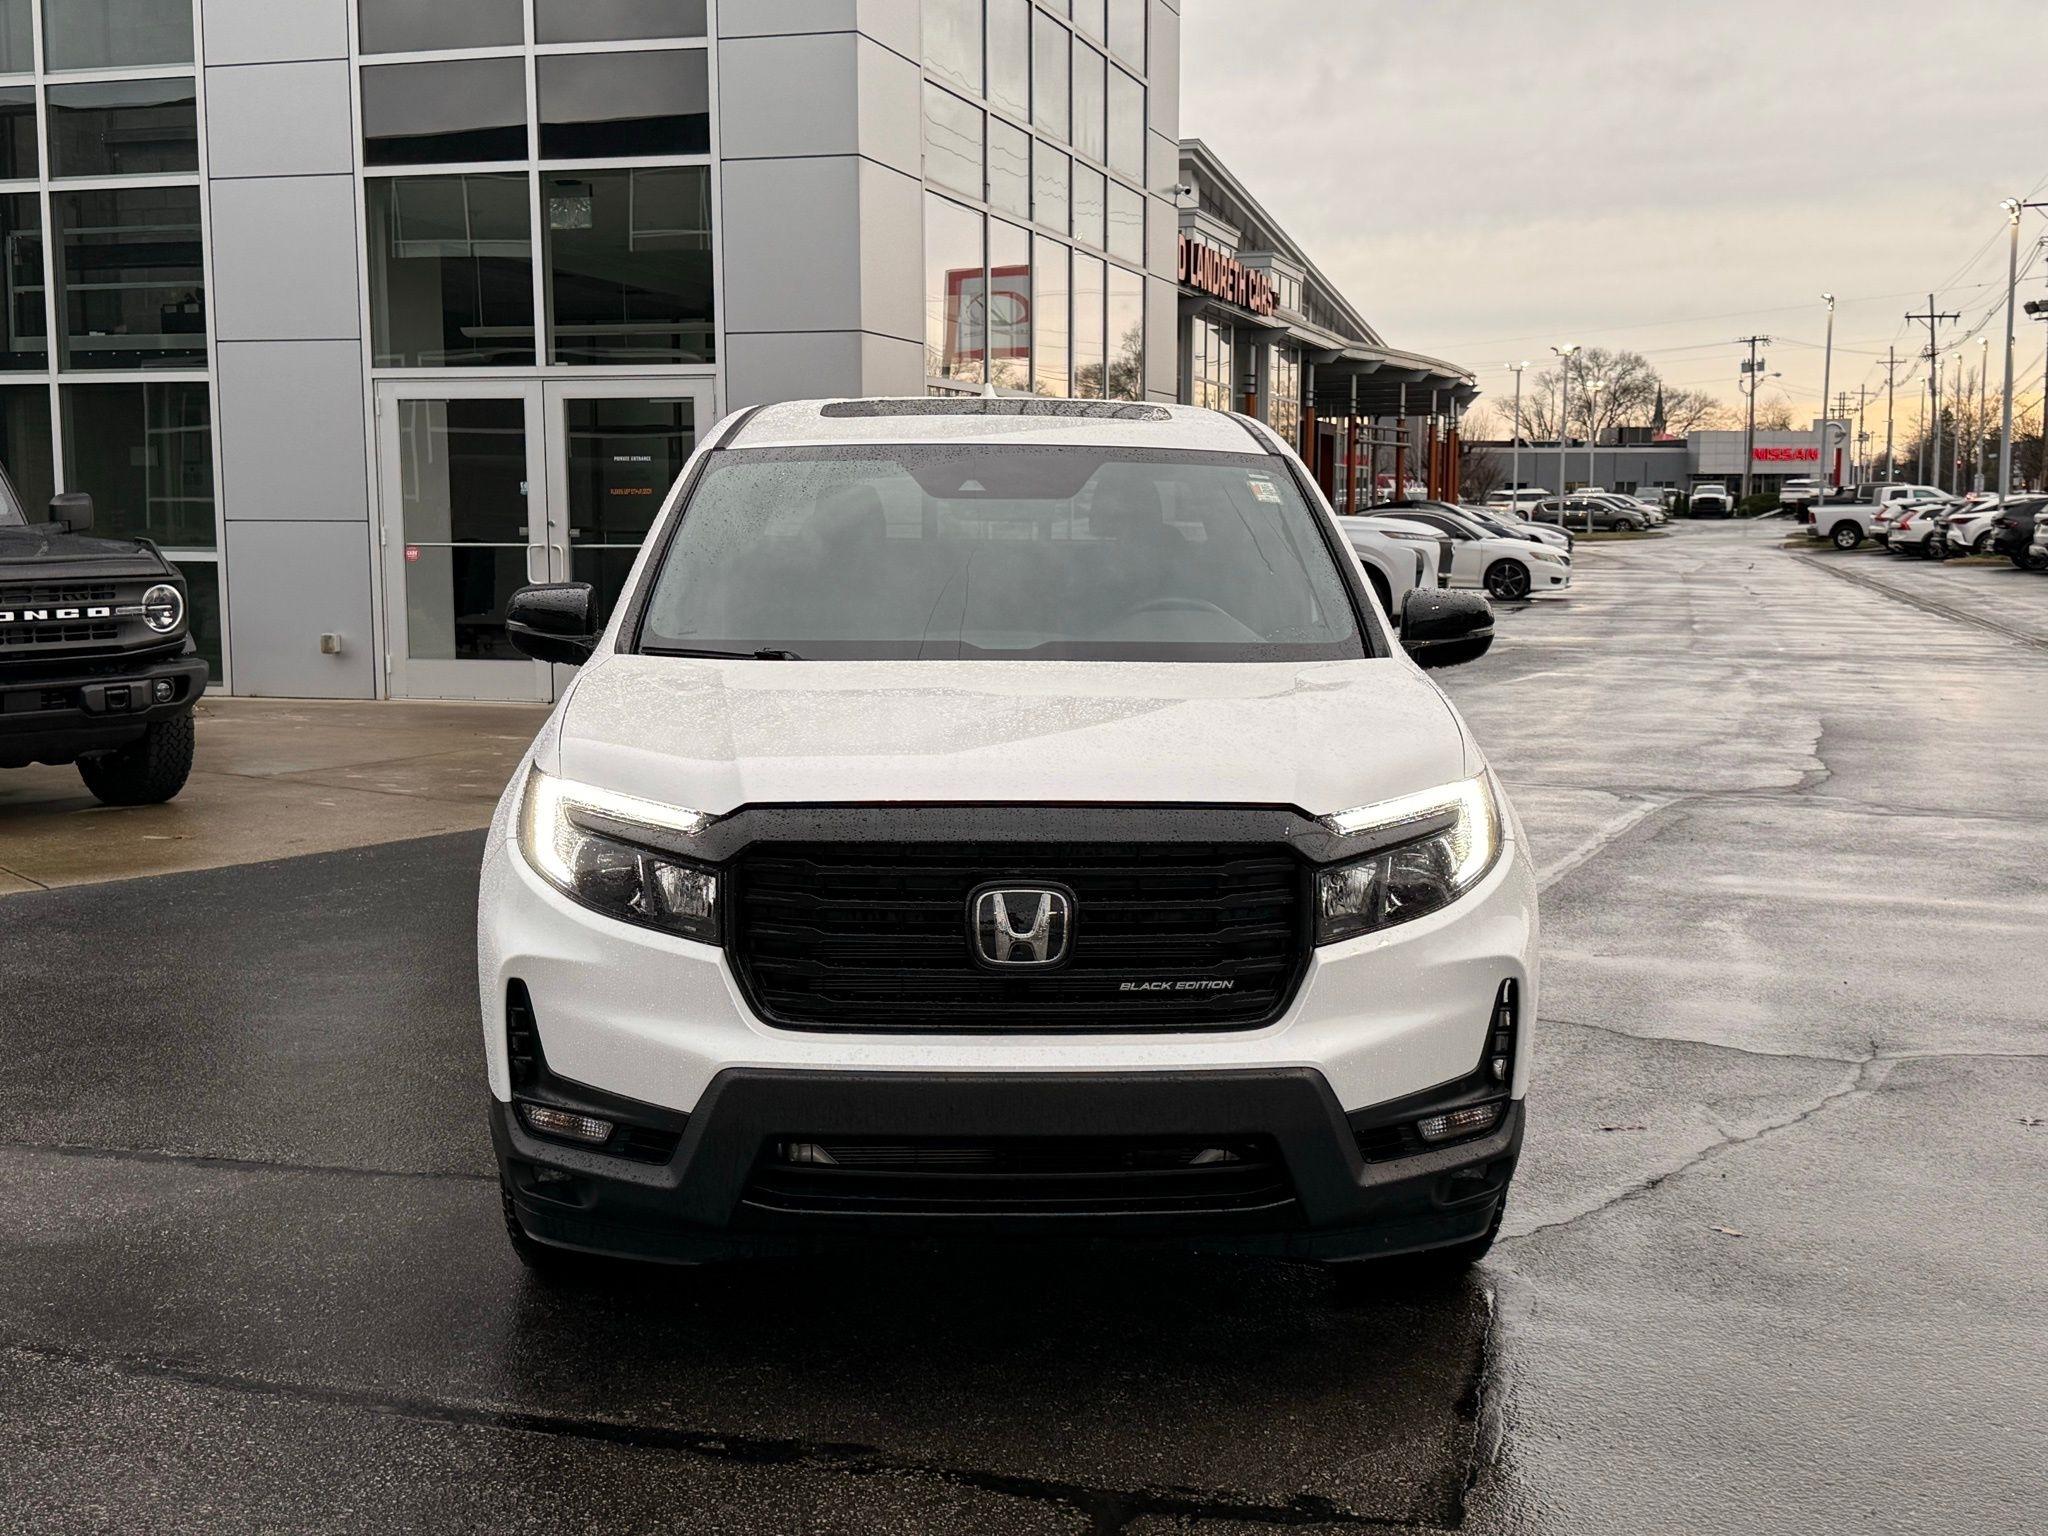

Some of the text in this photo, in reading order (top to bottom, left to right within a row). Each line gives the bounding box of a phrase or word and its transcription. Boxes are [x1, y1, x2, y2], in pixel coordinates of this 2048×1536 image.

[1190, 240, 1246, 307] LANDRETH
[1248, 268, 1272, 317] CARS
[1752, 447, 1819, 461] NISSAN
[1119, 979, 1235, 991] BLACK EDITION
